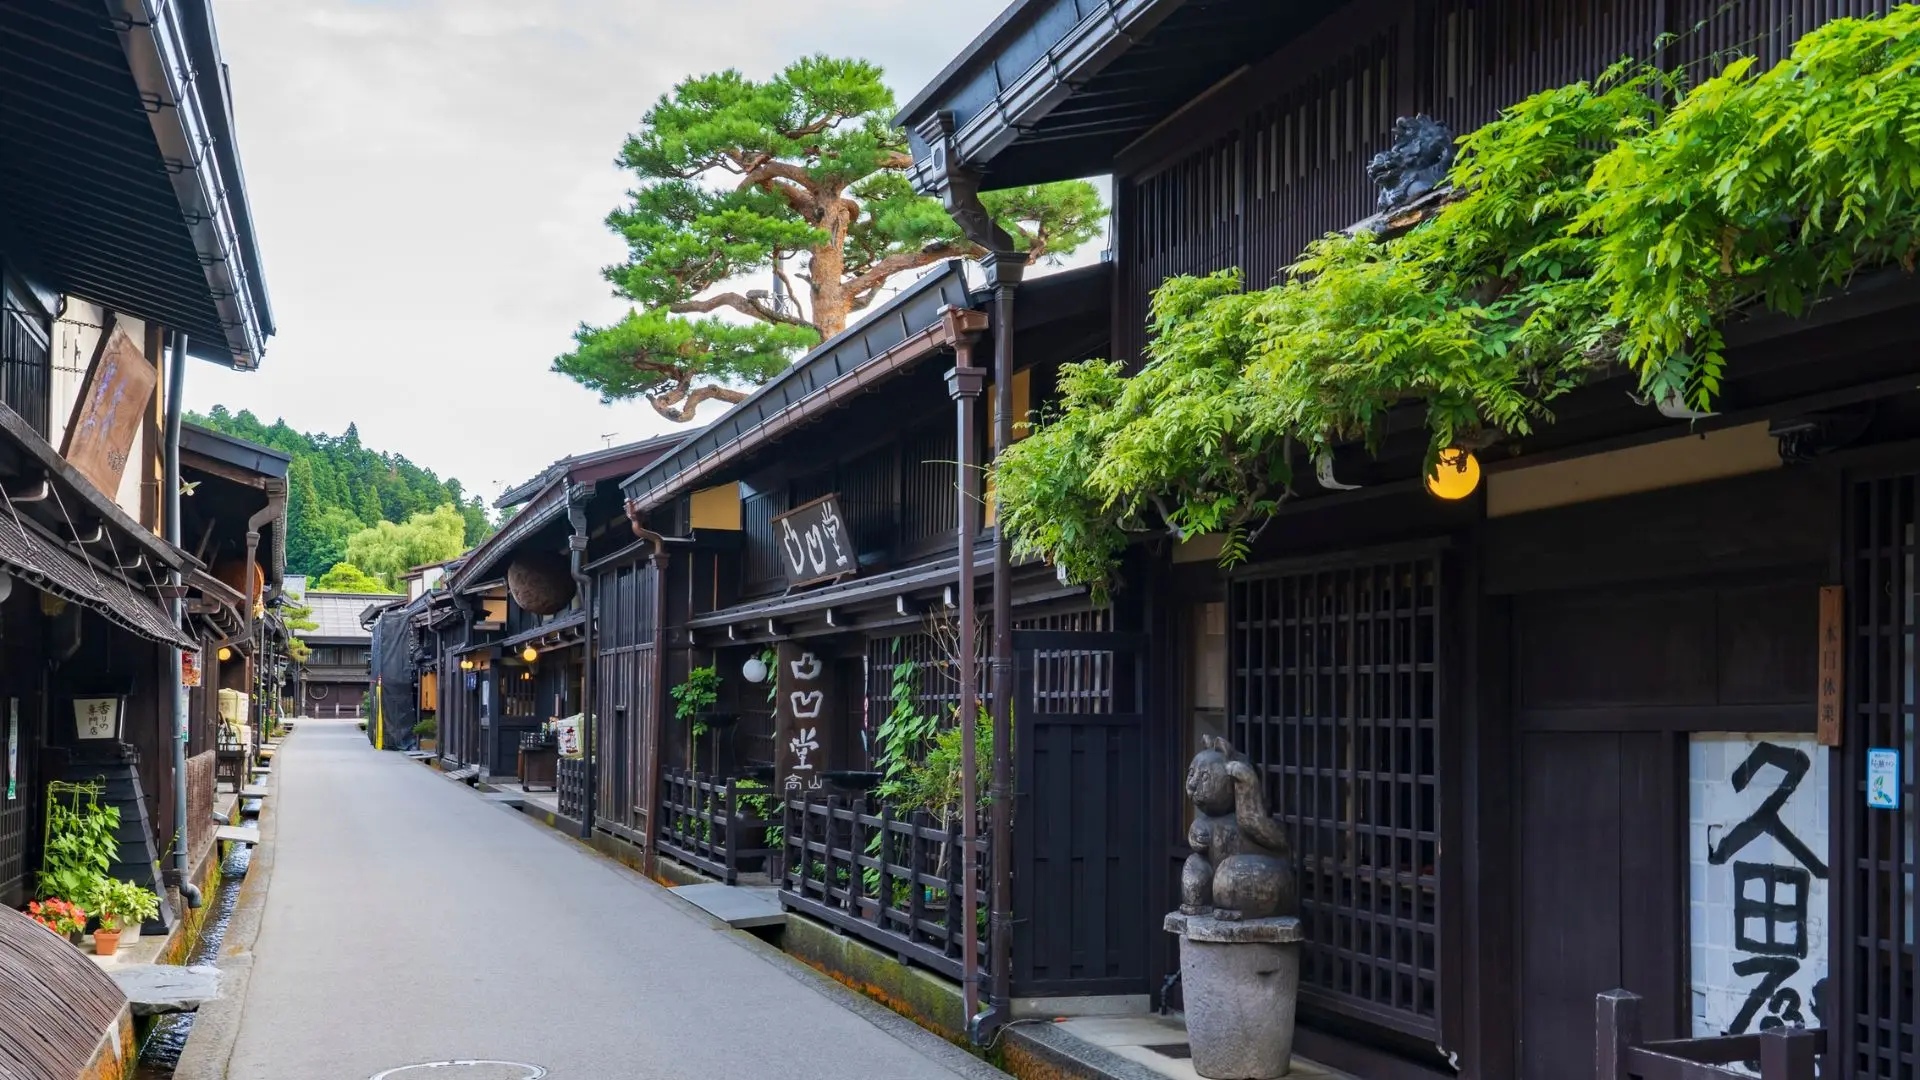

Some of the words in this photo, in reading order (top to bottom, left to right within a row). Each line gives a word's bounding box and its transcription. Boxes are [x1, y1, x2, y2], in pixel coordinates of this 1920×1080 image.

[789, 652, 824, 769] 凸凹堂
[784, 773, 823, 790] 高山
